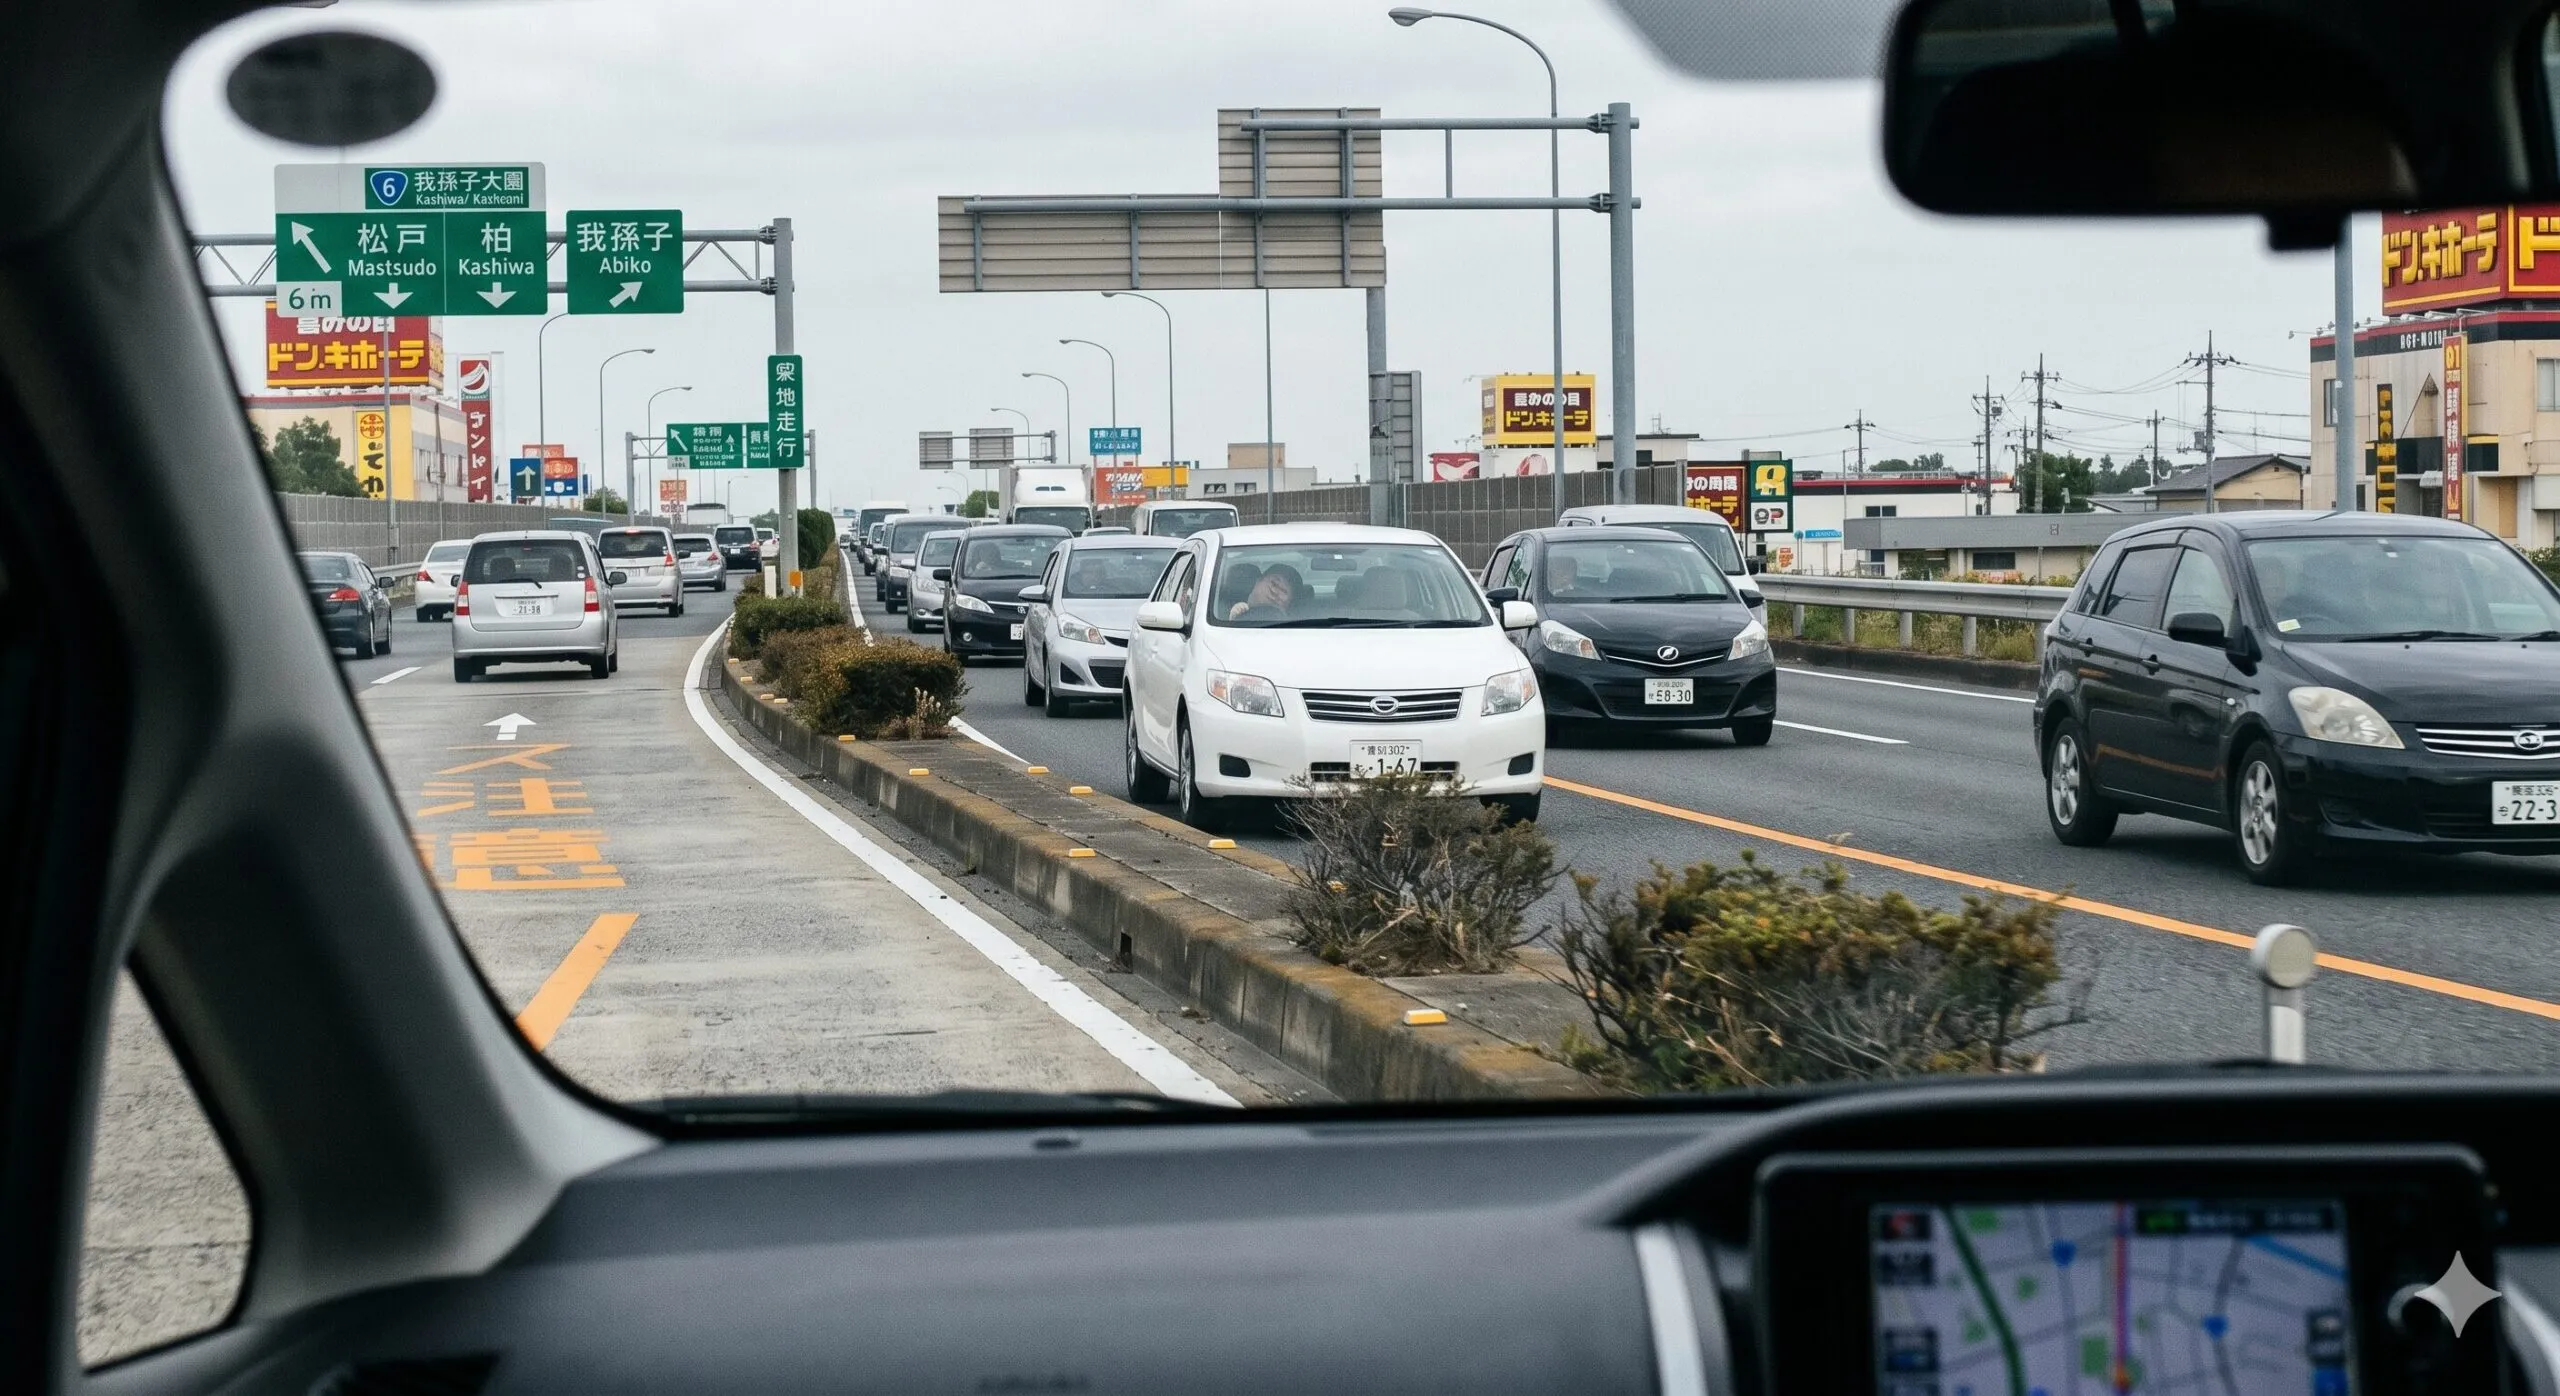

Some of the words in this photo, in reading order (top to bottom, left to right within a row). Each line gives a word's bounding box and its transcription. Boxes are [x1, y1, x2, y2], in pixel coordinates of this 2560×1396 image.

[382, 177, 396, 198] 6
[357, 223, 428, 254] 松戸
[480, 222, 512, 253] 柏
[576, 222, 673, 252] 我孫子
[348, 259, 437, 276] Mastsudo
[458, 258, 535, 275] Kashiwa
[599, 256, 652, 273] Abiko
[289, 287, 305, 309] 6
